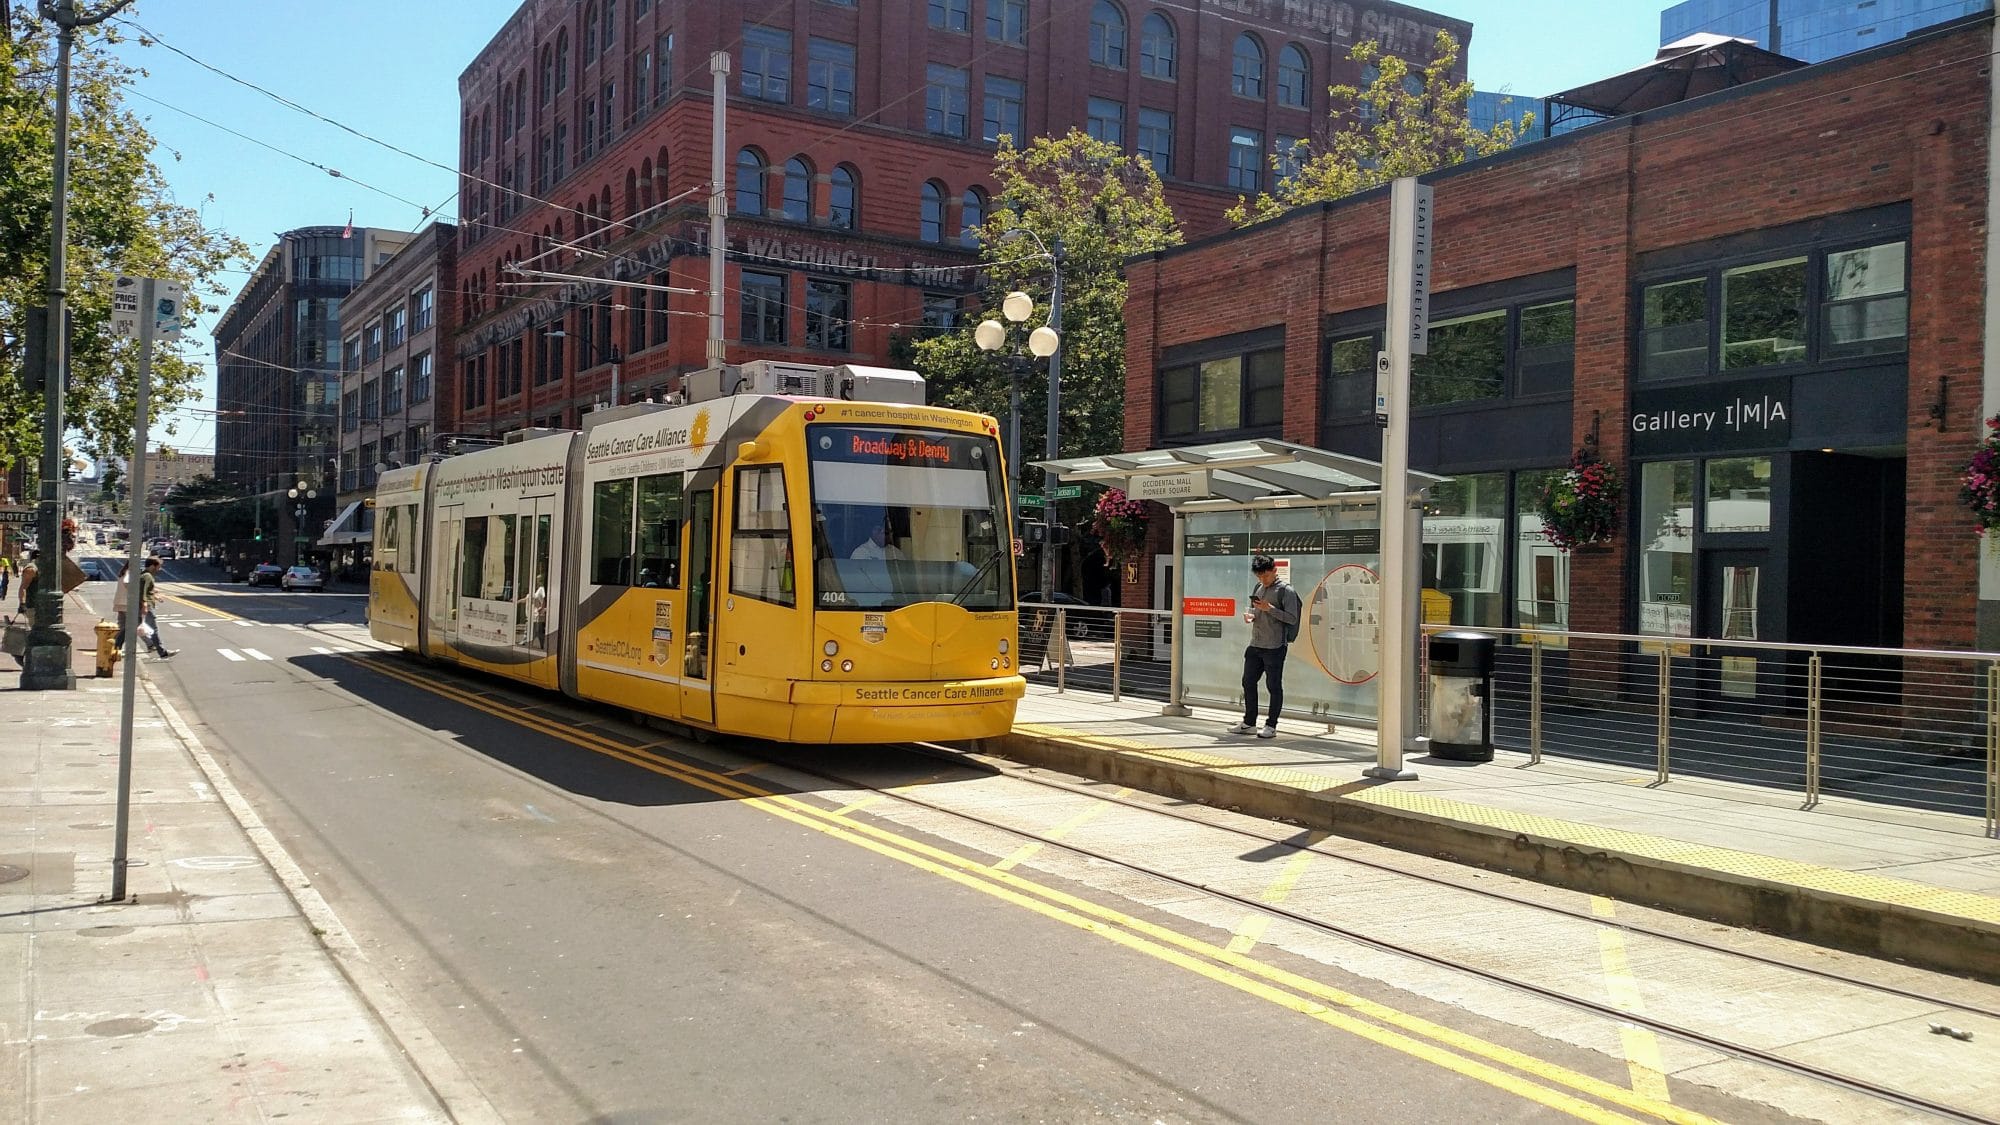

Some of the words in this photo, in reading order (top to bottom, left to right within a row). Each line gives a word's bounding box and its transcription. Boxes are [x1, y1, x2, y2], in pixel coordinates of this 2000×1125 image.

[1360, 9, 1459, 60] SHIRT
[1416, 198, 1426, 256] SEATTLE
[115, 293, 137, 303] PRICE
[1413, 263, 1424, 340] STREETCAR
[115, 302, 136, 311] BTM
[841, 409, 852, 417] #1
[855, 410, 885, 418] cancer
[886, 410, 920, 421] hospital
[922, 412, 929, 420] in
[930, 415, 973, 427] Washington
[1632, 410, 1716, 432] Gallery
[587, 439, 610, 460] Seattle
[611, 437, 635, 456] Cancer
[636, 433, 654, 451] Care
[654, 427, 687, 448] Alliance
[853, 435, 906, 460] Broadway
[908, 439, 917, 457] &
[919, 440, 950, 463] Denny
[159, 454, 184, 462] BUSH
[188, 455, 213, 464] HOTE
[497, 464, 540, 494] Washington
[541, 462, 564, 486] state
[1142, 480, 1175, 488] OCCIDENTAL
[1142, 488, 1166, 496] PIONEER
[1168, 486, 1191, 494] SQUARE
[0, 512, 34, 521] HOTEL
[822, 591, 847, 603] 404
[865, 614, 883, 622] BEST
[595, 637, 642, 665] SeattleCCA.org
[856, 688, 899, 700] Seattle
[902, 688, 941, 700] Cancer
[944, 688, 967, 699] Care
[969, 686, 1004, 698] Alliance
